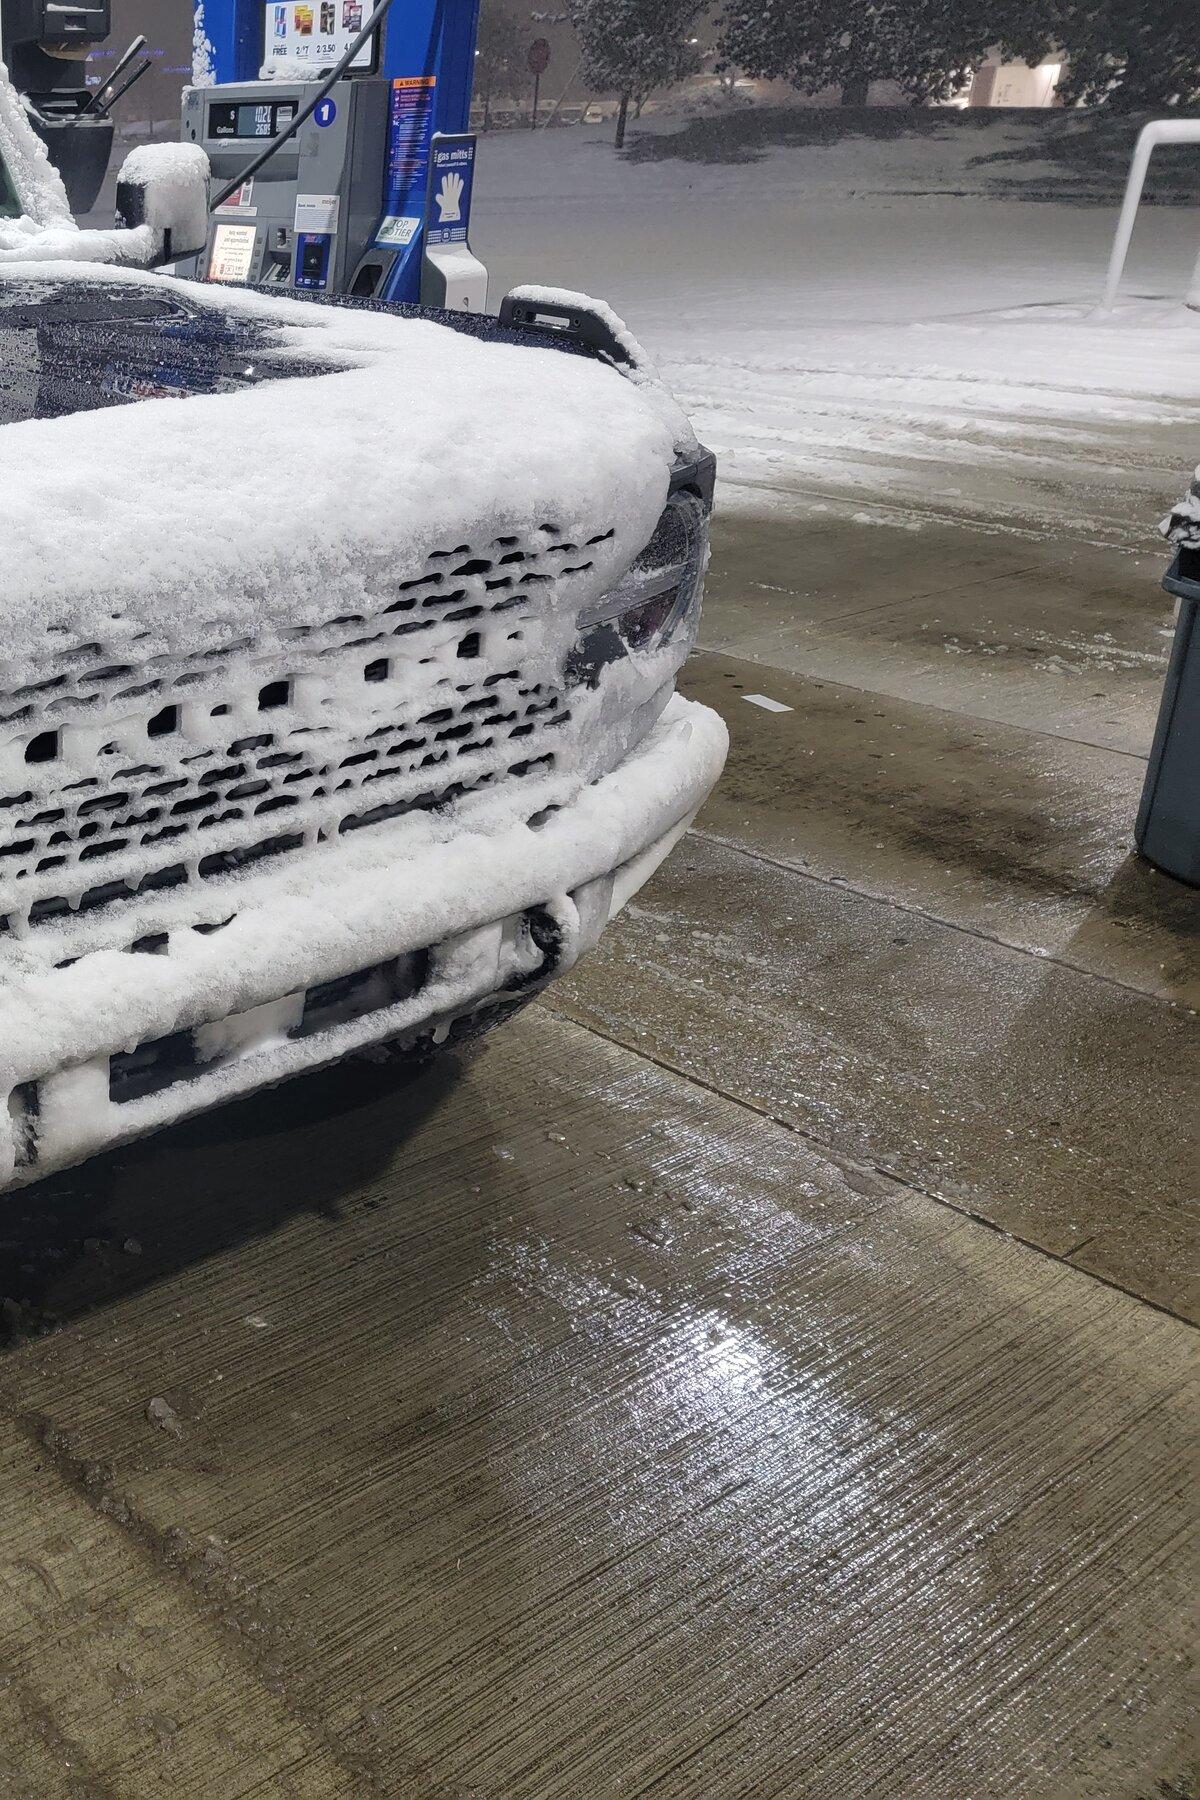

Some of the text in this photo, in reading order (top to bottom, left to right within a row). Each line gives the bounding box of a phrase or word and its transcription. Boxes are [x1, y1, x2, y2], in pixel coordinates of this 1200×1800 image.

[272, 47, 288, 56] FREE
[321, 105, 330, 120] 1
[437, 149, 468, 163] gas mitts
[392, 219, 409, 229] TOP
[394, 228, 412, 237] TIER
